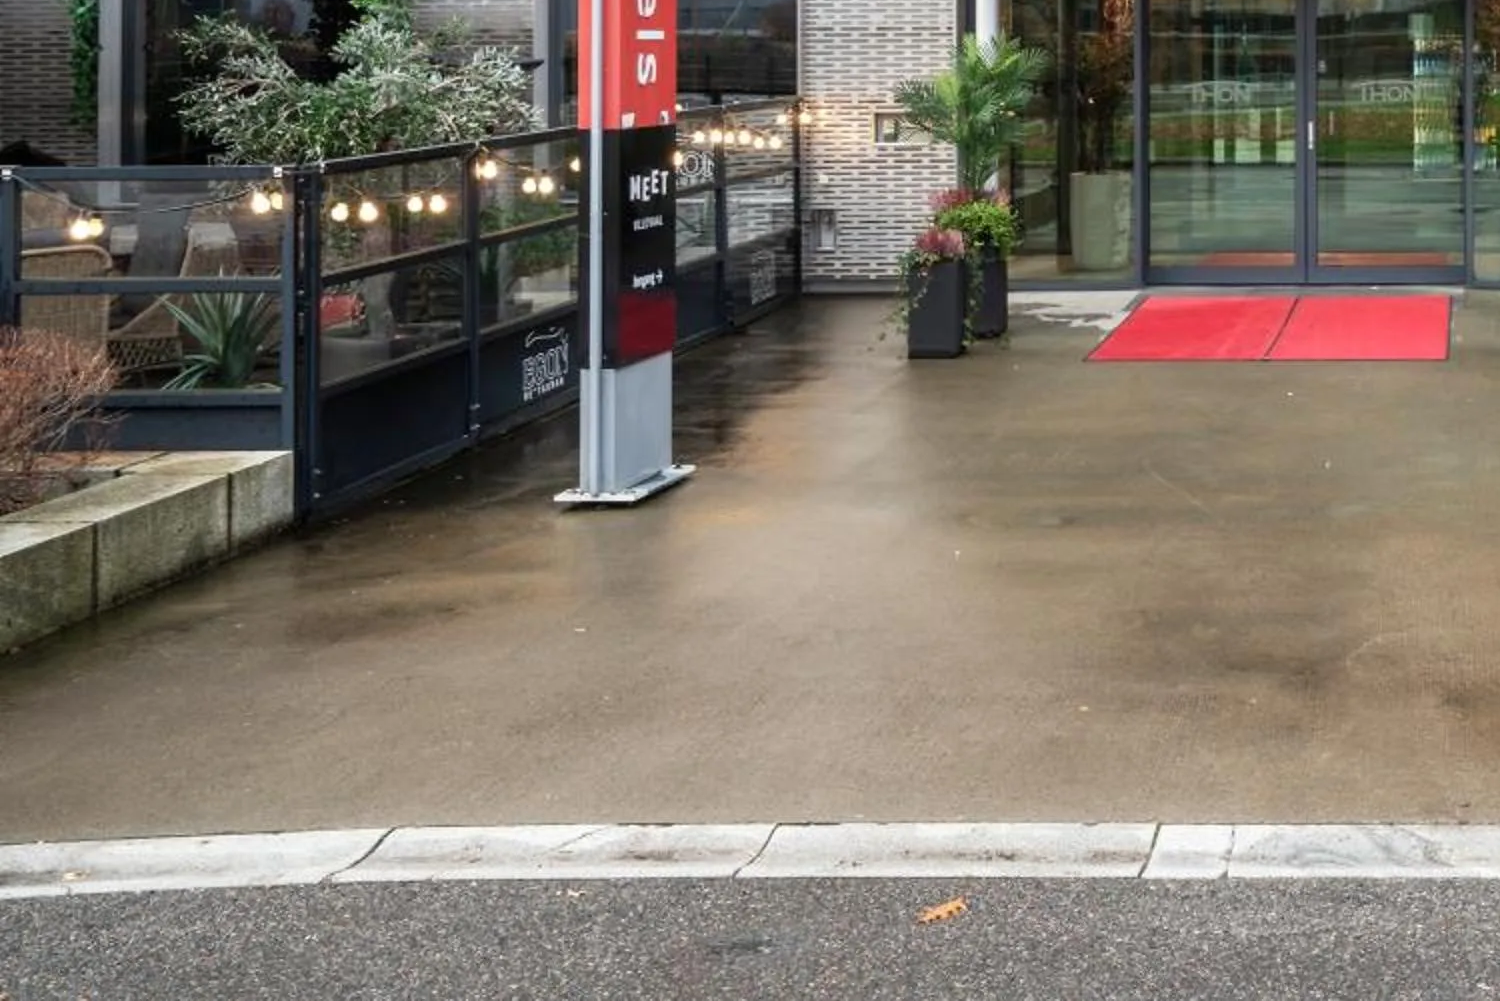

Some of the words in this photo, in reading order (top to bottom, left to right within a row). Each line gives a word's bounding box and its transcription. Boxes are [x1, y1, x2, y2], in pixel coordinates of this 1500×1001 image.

[1190, 85, 1250, 103] THON
[1360, 84, 1416, 102] THON
[629, 169, 669, 201] MEET
